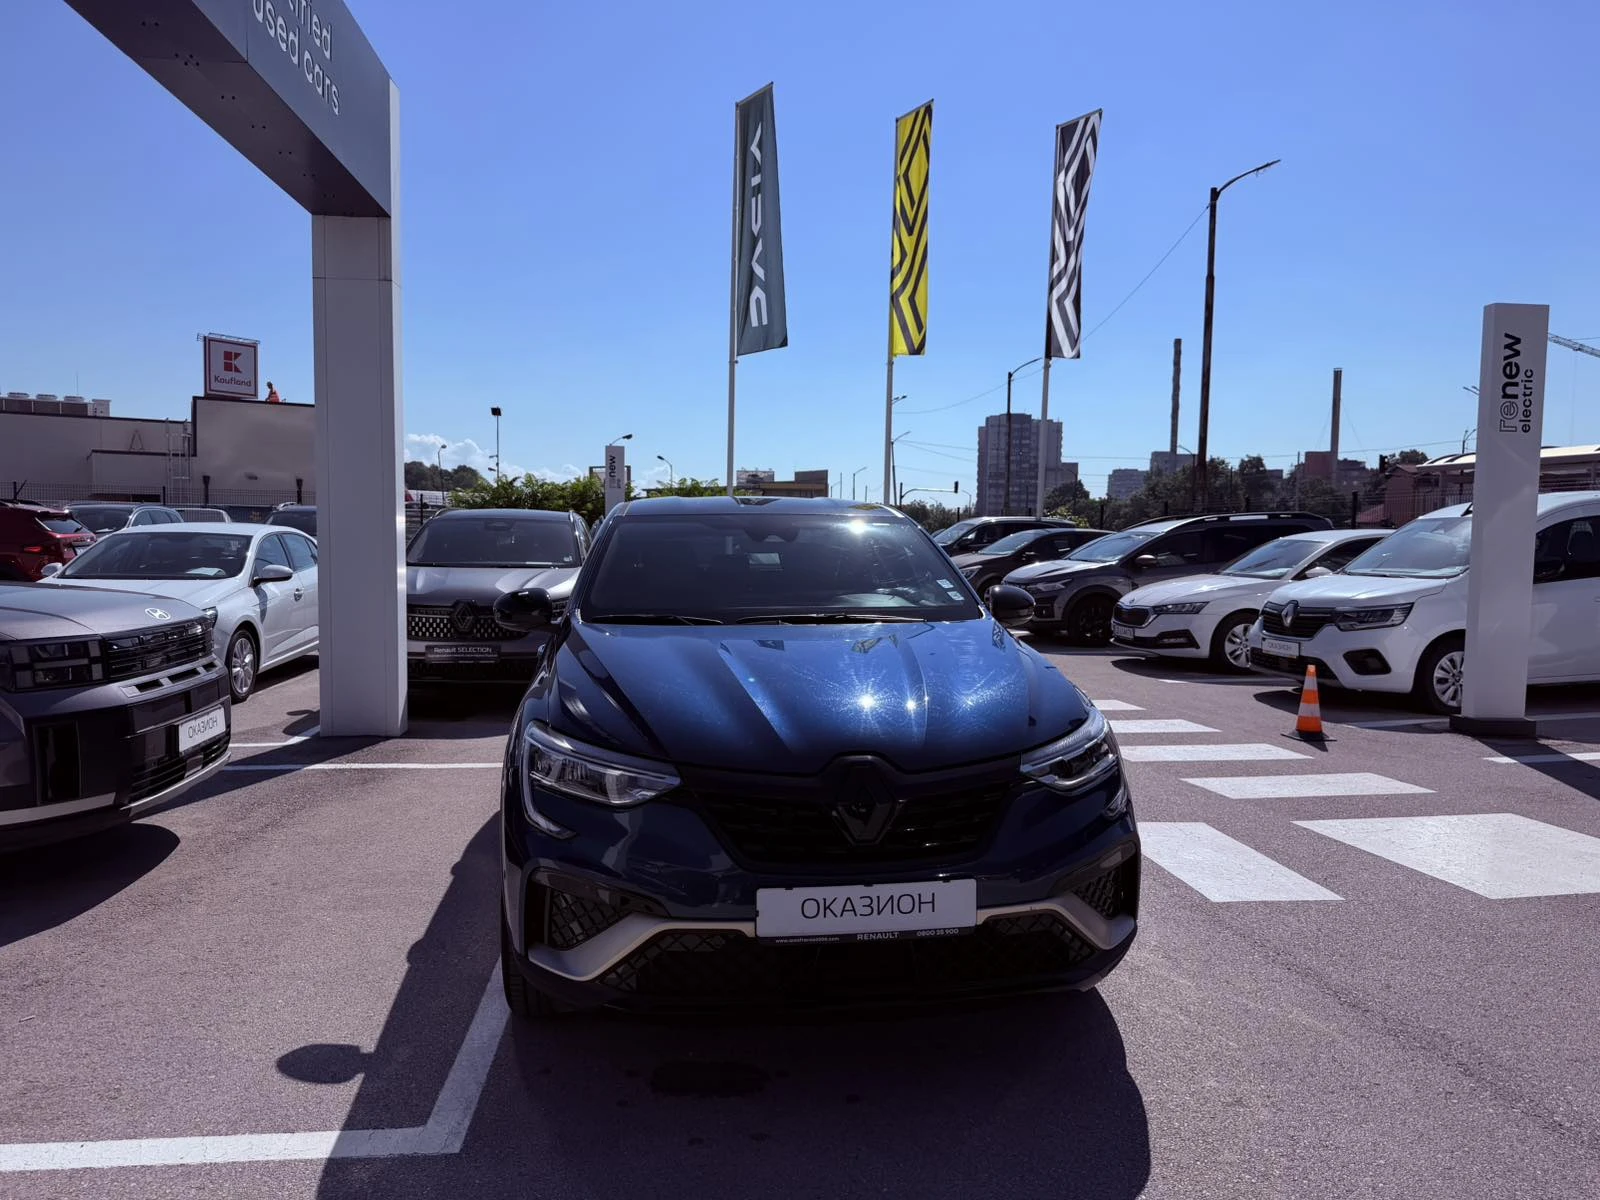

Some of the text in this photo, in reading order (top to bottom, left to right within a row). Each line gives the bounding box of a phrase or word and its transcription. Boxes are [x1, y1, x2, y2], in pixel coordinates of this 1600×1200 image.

[253, 0, 340, 116] used cars
[214, 375, 252, 387] Kaufland
[1499, 332, 1522, 433] renew
[1518, 368, 1534, 434] electric
[801, 892, 936, 920] ОКАЗИОН
[857, 931, 899, 941] RENAULT
